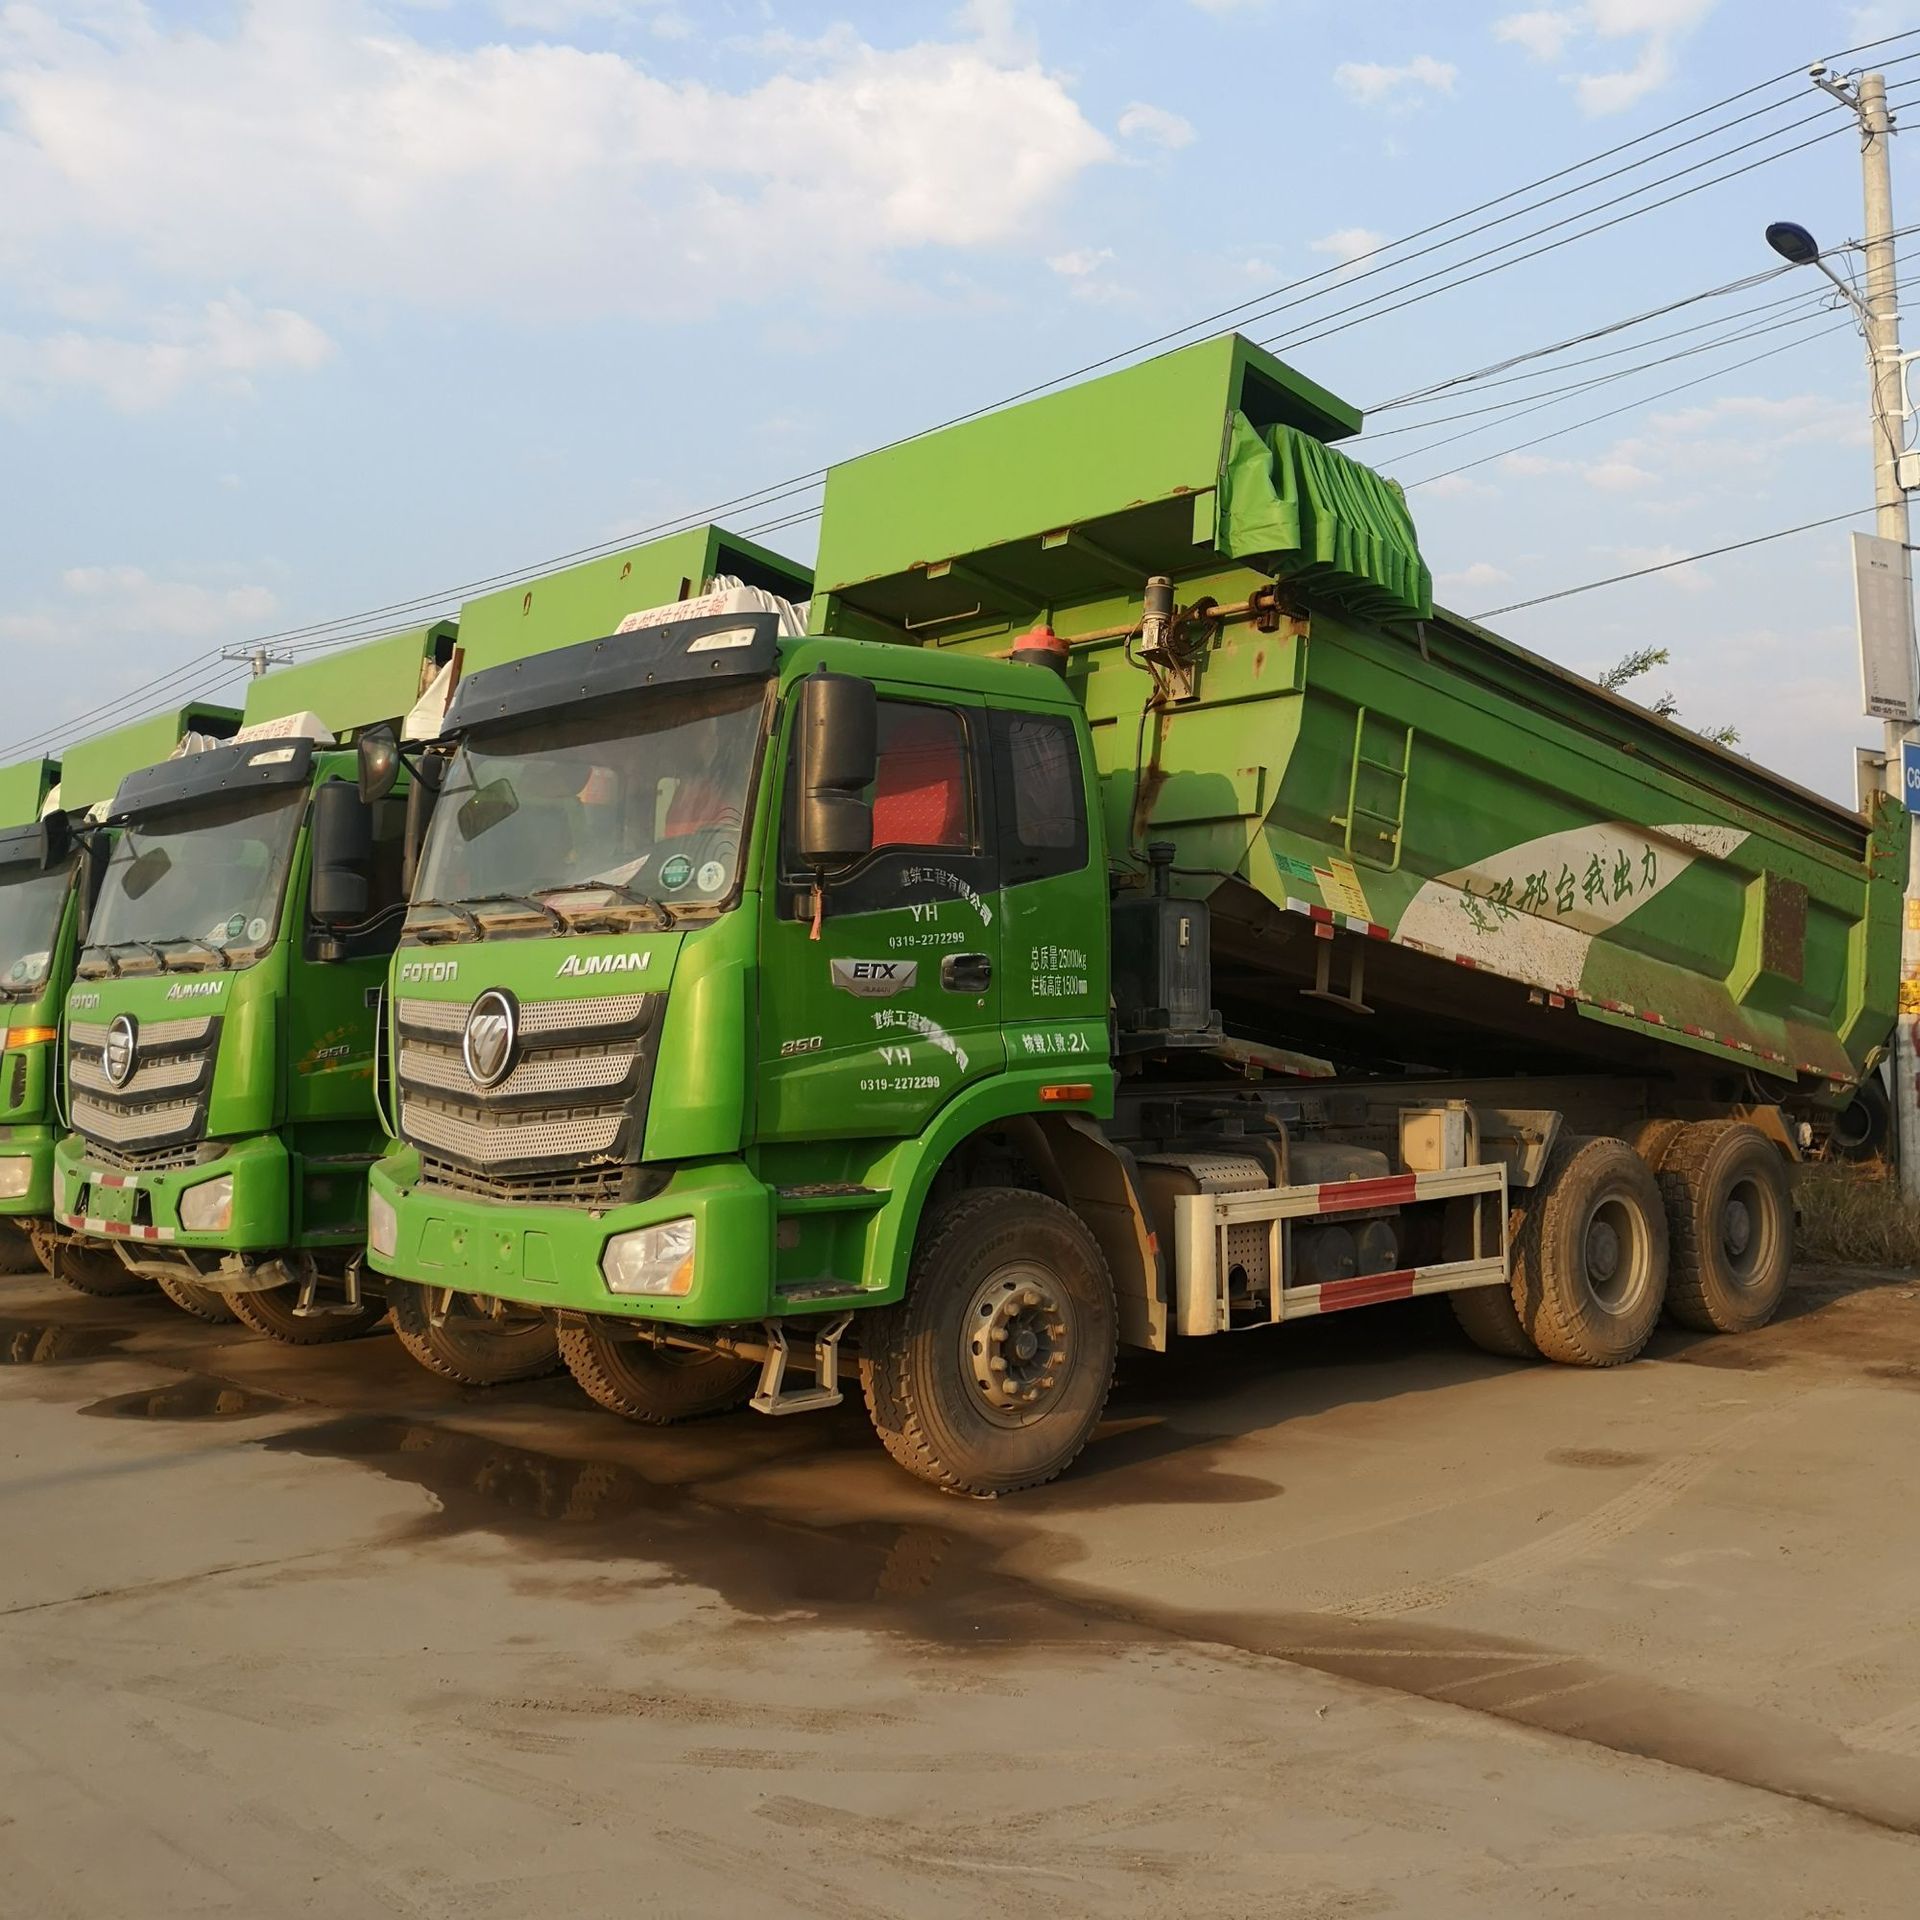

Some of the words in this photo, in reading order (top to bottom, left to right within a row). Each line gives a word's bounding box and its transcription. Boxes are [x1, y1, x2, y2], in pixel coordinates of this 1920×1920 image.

[909, 904, 938, 922] YH
[888, 931, 965, 949] 0319-2272299
[401, 961, 459, 983] FOTON
[554, 952, 651, 978] AUMAN
[853, 963, 898, 979] ETX
[166, 980, 224, 1000] AUMAN
[878, 1047, 912, 1066] YH
[860, 1076, 941, 1092] 0319-2272299
